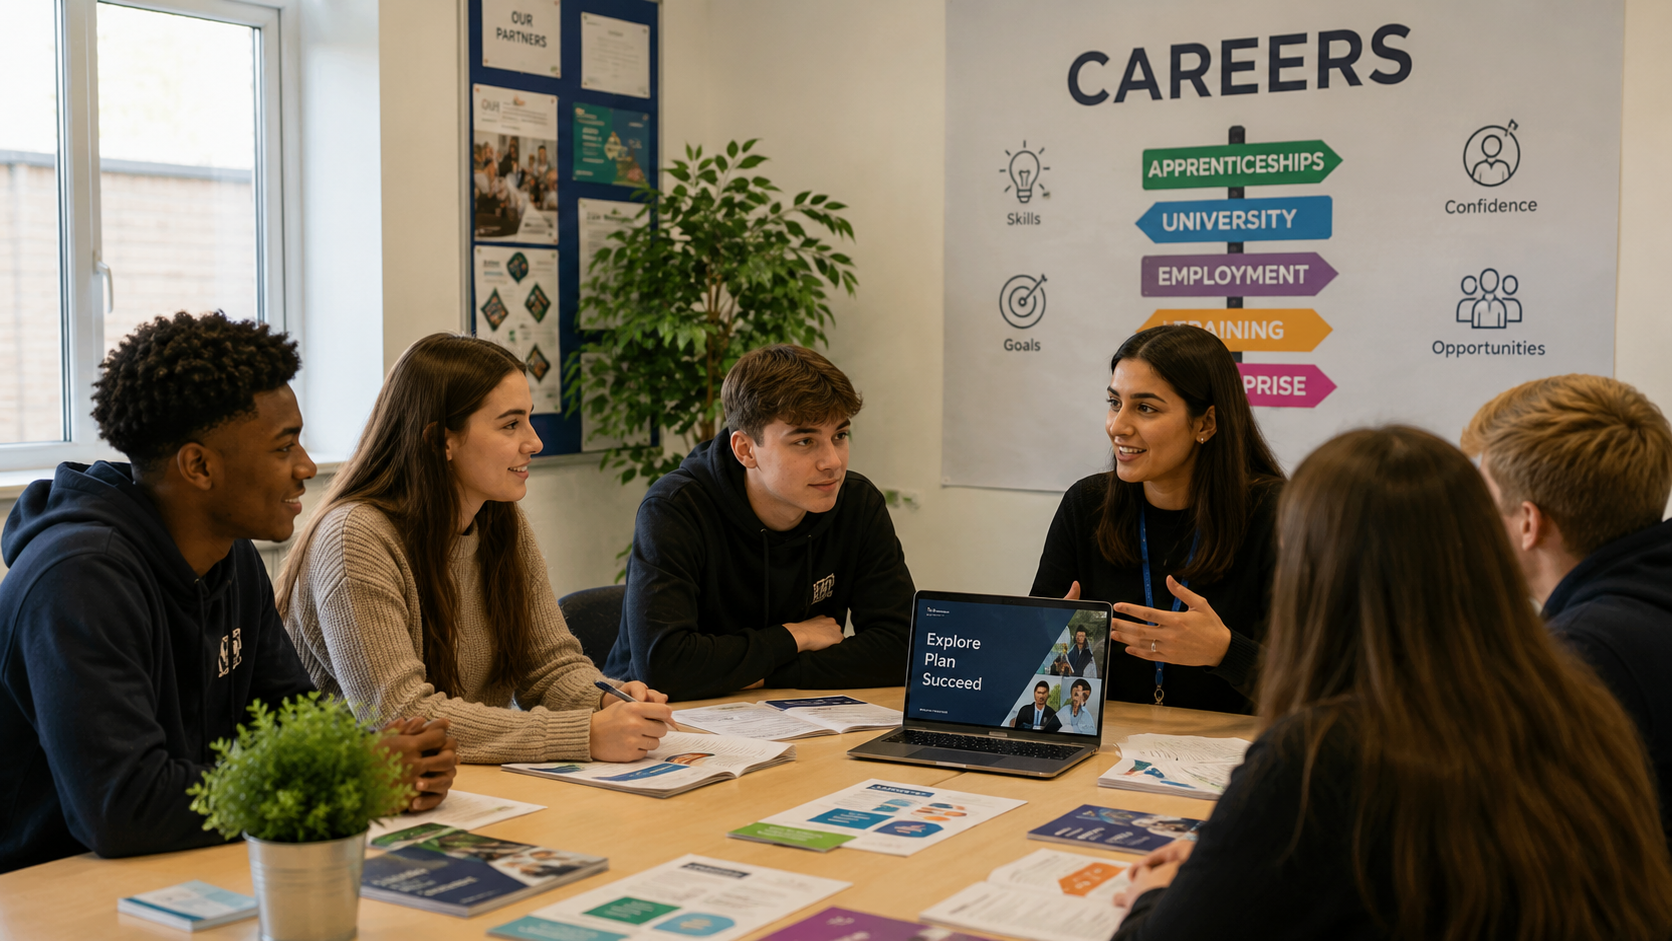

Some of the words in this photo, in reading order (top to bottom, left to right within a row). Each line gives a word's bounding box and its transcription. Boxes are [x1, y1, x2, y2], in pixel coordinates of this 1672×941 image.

[511, 11, 533, 27] OUR
[496, 27, 547, 48] PARTNERS
[1067, 23, 1413, 107] CAREERS
[1148, 151, 1325, 179] APPRENTICESHIPS
[1444, 198, 1538, 215] Confidence
[1006, 211, 1042, 226] Skills
[1161, 208, 1297, 232] UNIVERSITY
[1158, 264, 1309, 287] EMPLOYMENT
[1173, 319, 1284, 340] AINING
[1003, 337, 1041, 352] Goals
[1431, 340, 1546, 358] Opportunities
[1243, 375, 1307, 396] PRISE
[926, 632, 981, 650] Explore
[924, 652, 956, 669] Plan
[922, 672, 982, 691] Succeed
